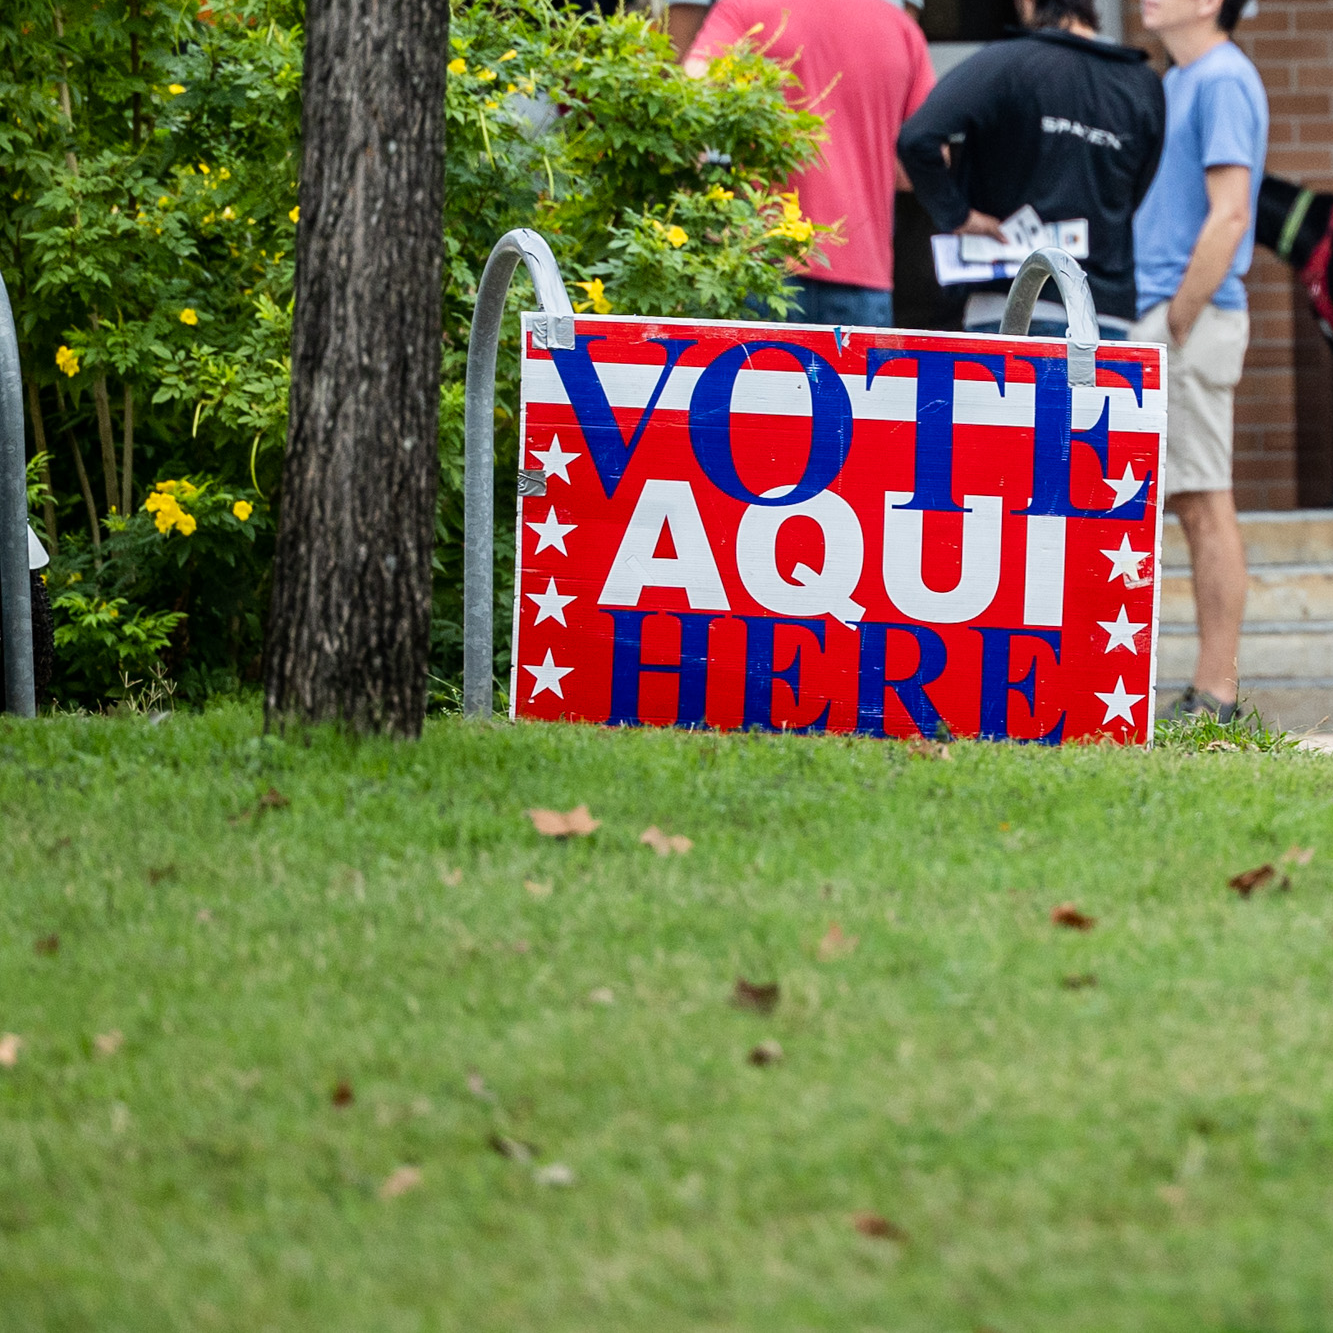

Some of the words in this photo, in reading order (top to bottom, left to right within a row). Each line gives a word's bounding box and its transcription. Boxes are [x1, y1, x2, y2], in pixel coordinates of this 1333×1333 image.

[548, 334, 1153, 521] VOTE
[597, 478, 1067, 632] AQUI
[599, 608, 1067, 747] HERE
